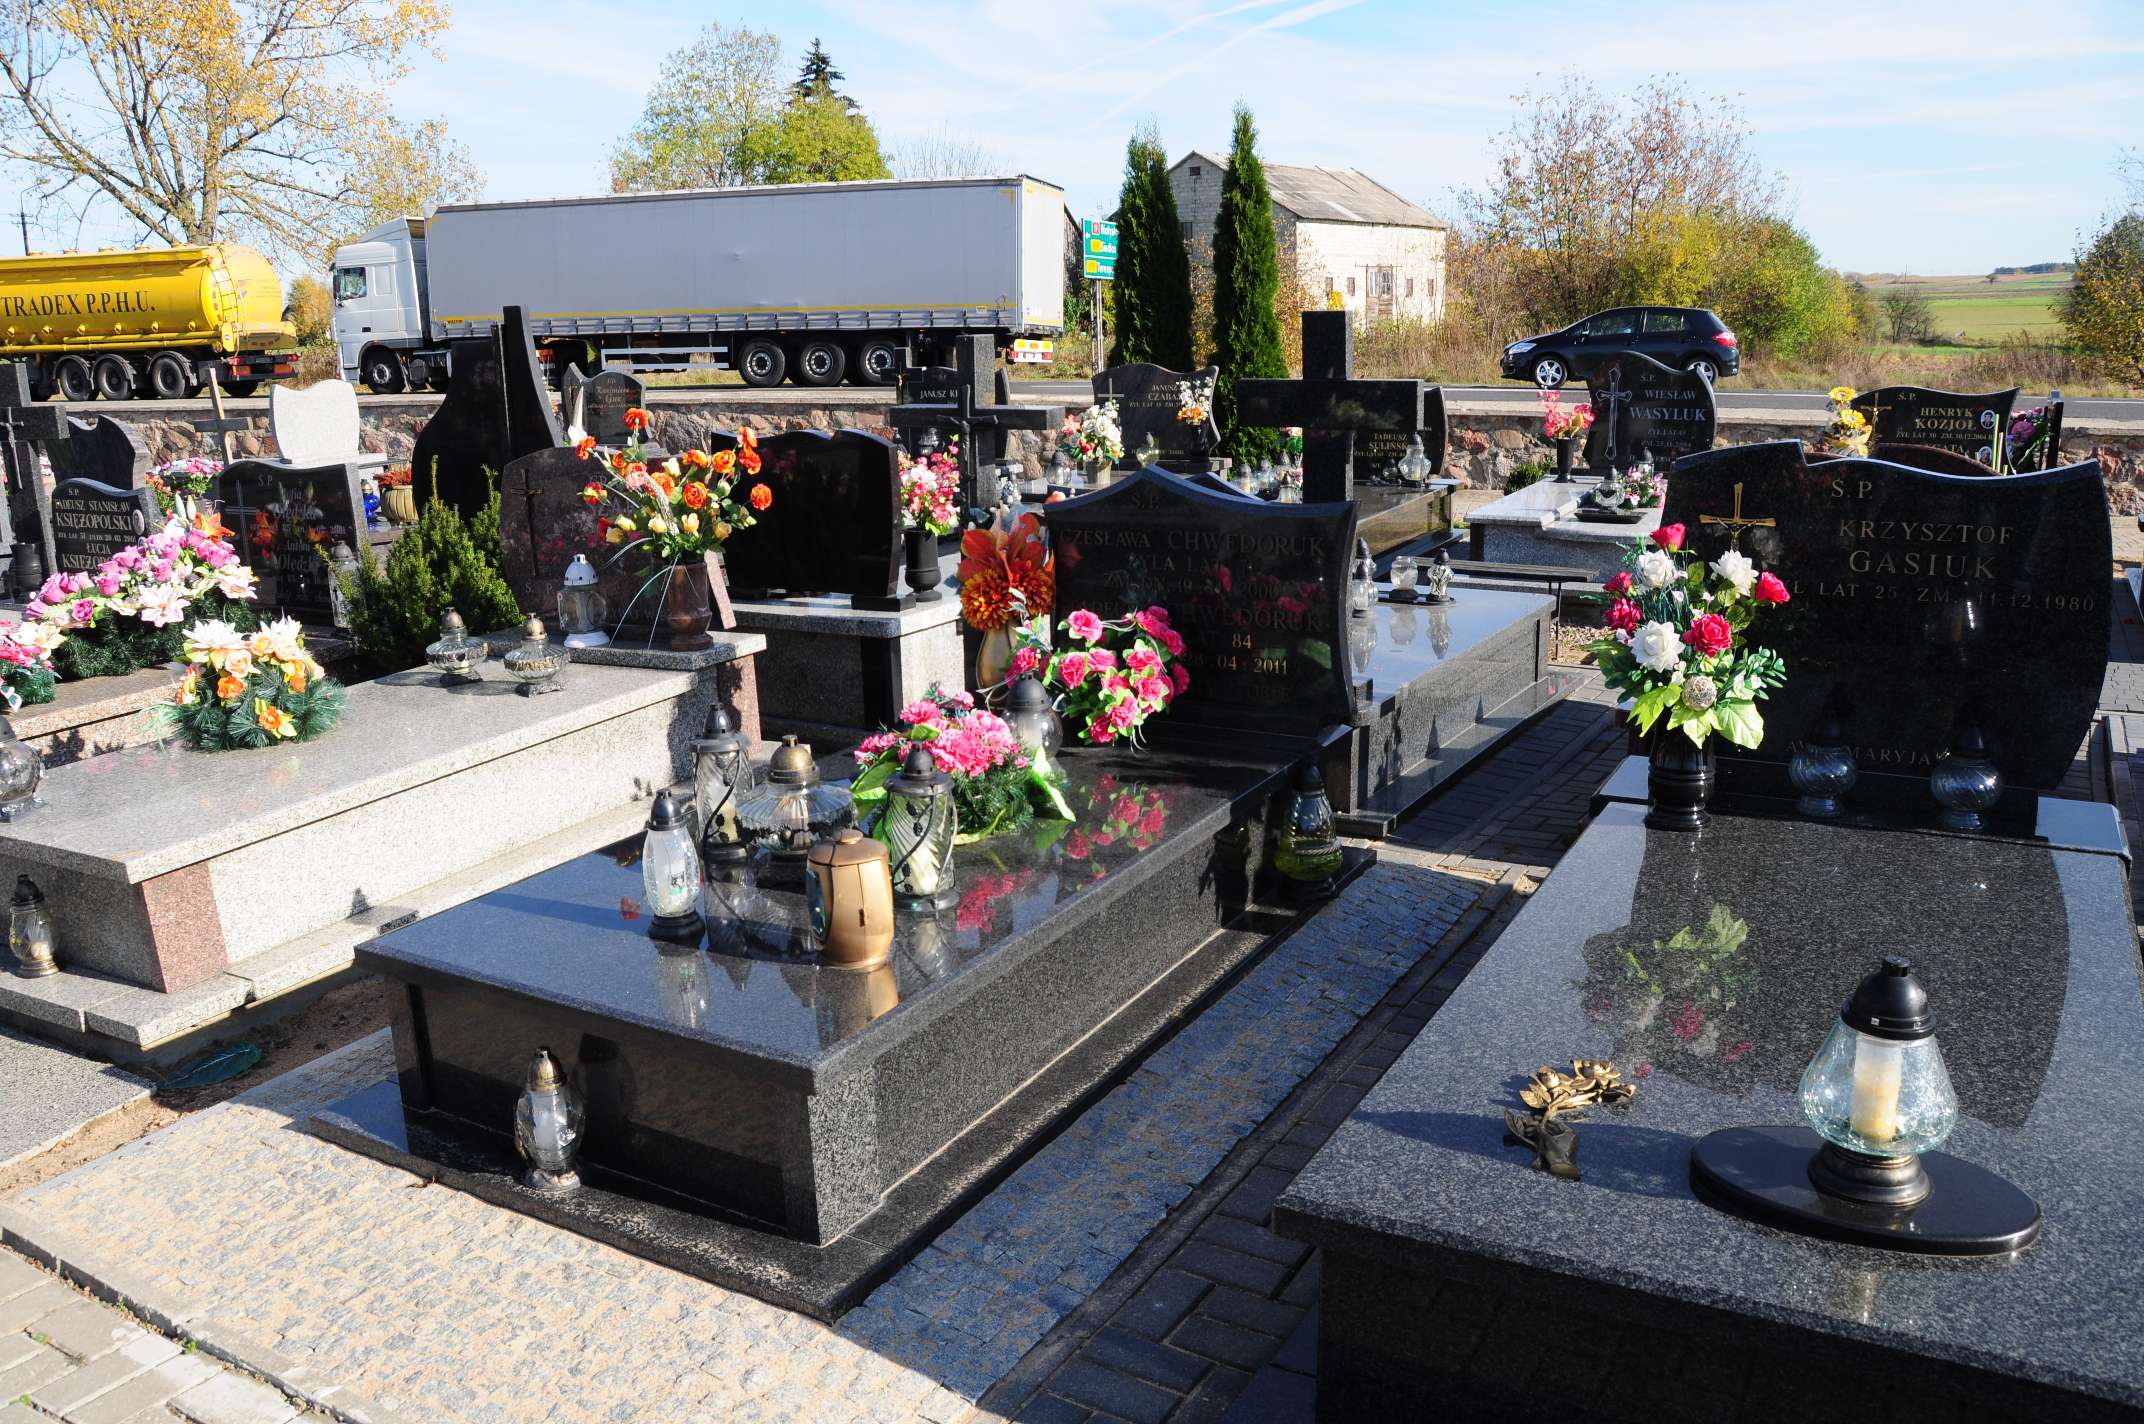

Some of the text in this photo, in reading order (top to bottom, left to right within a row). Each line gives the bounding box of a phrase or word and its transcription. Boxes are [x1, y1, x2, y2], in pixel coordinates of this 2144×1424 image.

[0, 290, 156, 317] TRADEX P.P.H.U.
[920, 389, 947, 399] JANUSZ
[1644, 389, 1697, 400] WIESŁAW
[1630, 406, 1706, 421] WASYLUK
[1920, 407, 1974, 417] HENRYK
[1374, 433, 1408, 441] TADEUSZ
[55, 499, 131, 513] TADEUSZ STANISŁAW
[56, 512, 133, 531] KSIĘŻOPOLSKI
[1839, 519, 2014, 545] KRZYSZTOF
[86, 543, 112, 555] ŁUCJA
[1167, 530, 1327, 558] CHWEDORUK
[1849, 549, 1997, 580] GASIUK
[1819, 582, 1860, 598] LAT
[1874, 585, 1897, 600] 25
[1231, 632, 1252, 649] 84
[1217, 655, 1238, 671] 04
[1252, 657, 1289, 675] 2011
